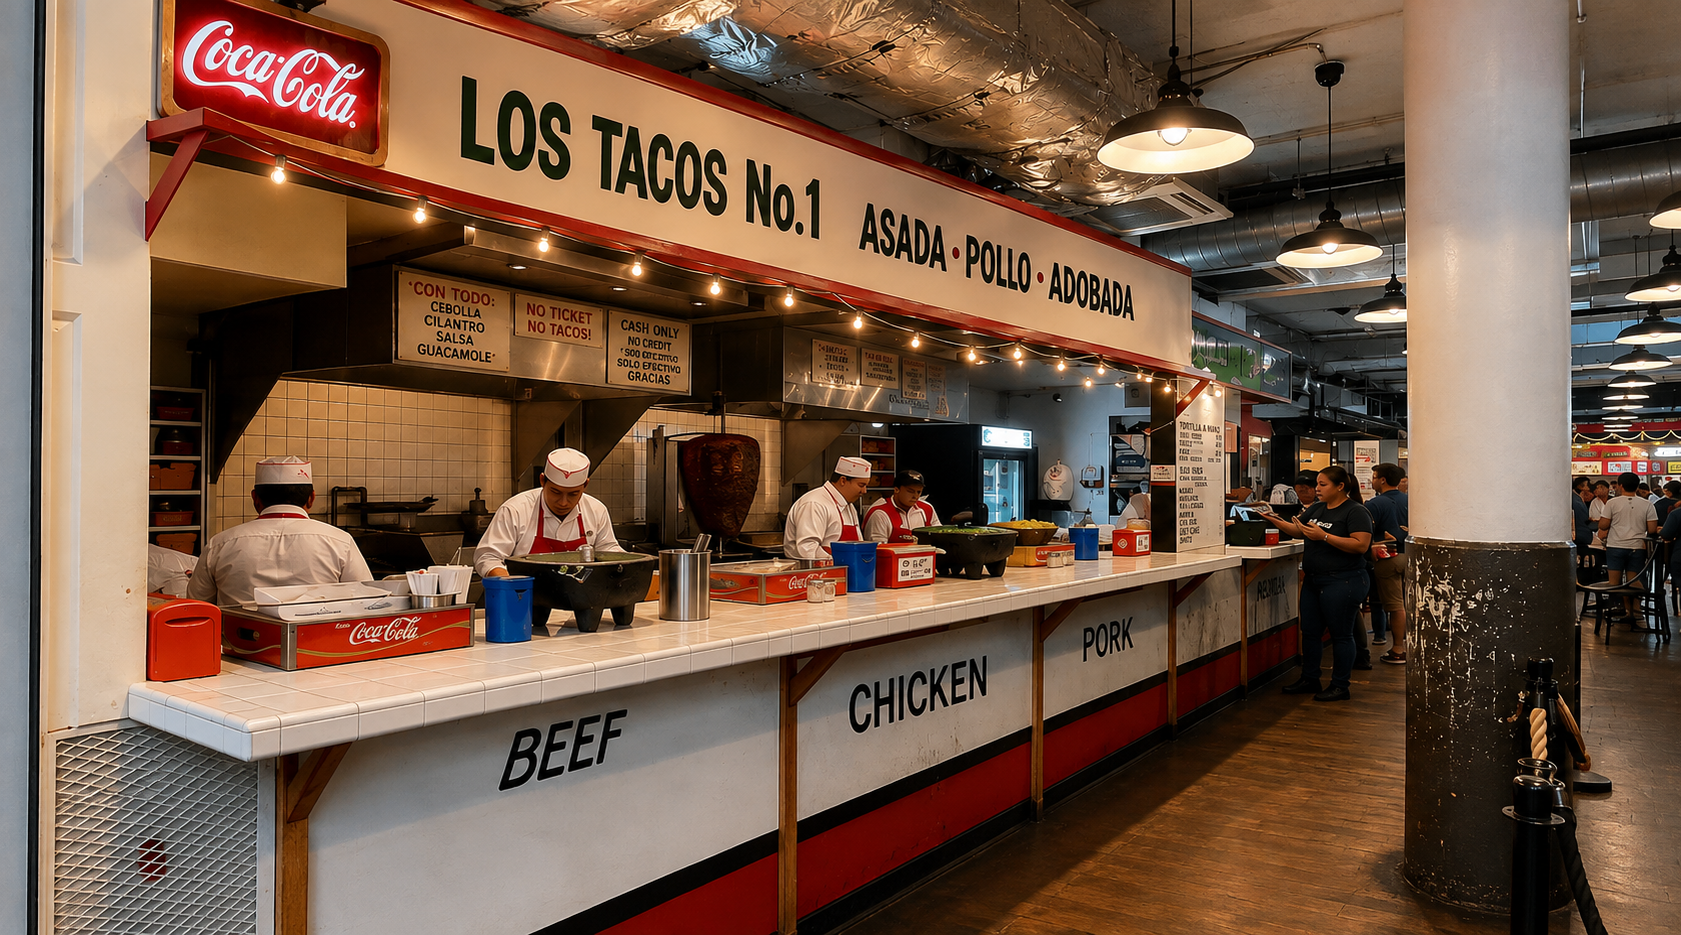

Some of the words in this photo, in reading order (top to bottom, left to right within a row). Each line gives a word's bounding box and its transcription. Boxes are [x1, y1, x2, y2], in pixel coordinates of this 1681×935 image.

[461, 75, 571, 181] LOS
[592, 114, 728, 216] TACOS
[746, 158, 820, 240] No.1
[859, 203, 947, 272] ASADA
[965, 234, 1031, 293] POLLO
[1048, 262, 1135, 321] ADOBADA
[451, 287, 495, 307] TODO:
[430, 301, 482, 319] CEBOLLA
[526, 302, 546, 317] NO
[550, 306, 593, 325] TICKET
[424, 314, 485, 333] CILANTRO
[528, 320, 546, 334] NO
[550, 323, 592, 341] TACOS!
[621, 319, 649, 334] CASH
[653, 325, 679, 339] ONLY
[436, 330, 474, 346] SALSA
[628, 336, 640, 346] NO
[643, 338, 672, 352] CREDIT
[617, 358, 640, 369] SOLO
[627, 370, 671, 385] GRACIAS
[1082, 616, 1134, 663] PORK
[849, 655, 988, 734] CHICKEN
[498, 708, 628, 792] BEEF
